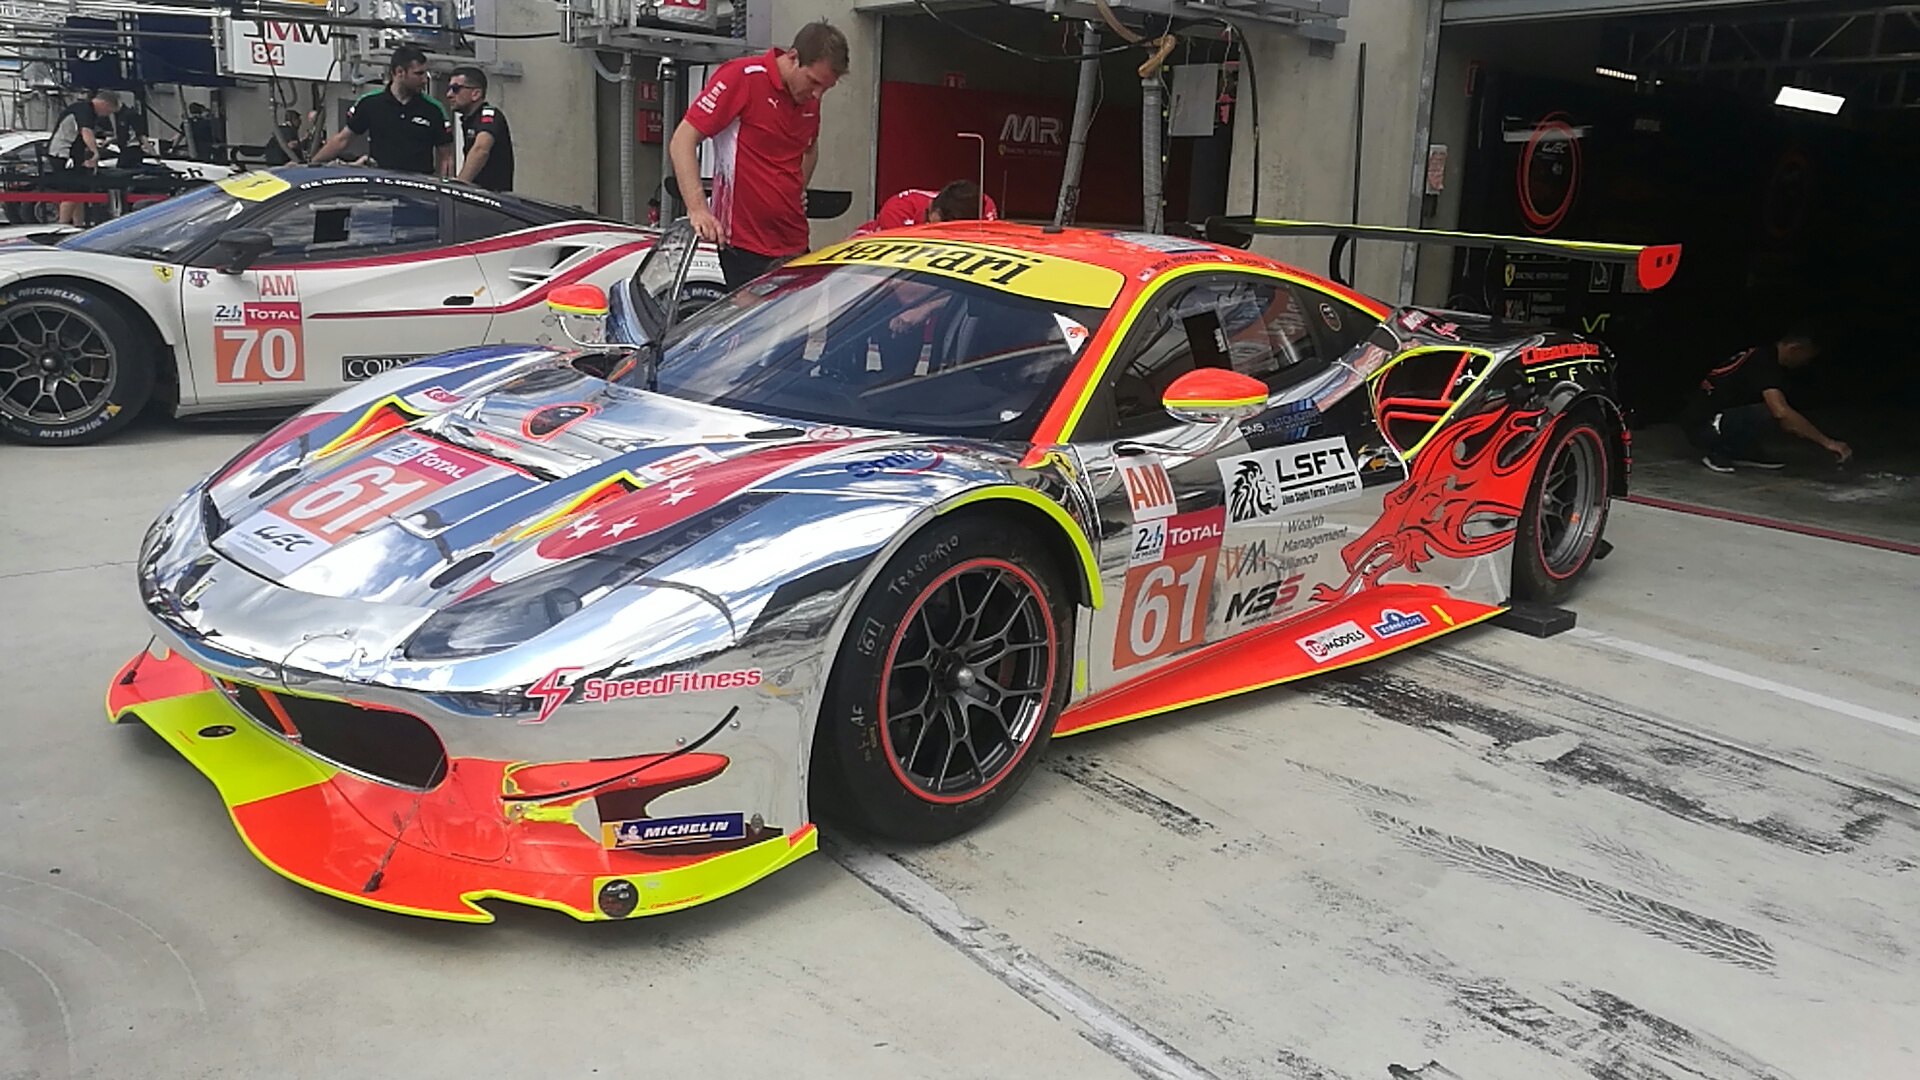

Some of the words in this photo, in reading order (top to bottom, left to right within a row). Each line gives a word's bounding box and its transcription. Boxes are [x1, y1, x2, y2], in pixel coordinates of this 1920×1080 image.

[411, 6, 438, 24] 31
[253, 43, 283, 64] 84
[1000, 113, 1063, 145] MR
[818, 239, 1043, 286] Ferrari
[18, 287, 85, 304] MICHELIN
[261, 275, 295, 296] AM
[246, 308, 300, 320] TOTAL
[223, 328, 297, 379] 70
[416, 452, 466, 478] TOTAL
[1275, 447, 1345, 483] LSFT
[288, 466, 429, 534] 61
[1126, 463, 1173, 511] AM
[1169, 523, 1222, 546] TOTAL
[1287, 513, 1325, 534] Wealth
[253, 525, 314, 552] WEC
[1282, 525, 1348, 554] Management
[1130, 555, 1207, 658] 61
[583, 668, 762, 704] SpeedFitness
[644, 821, 729, 839] MICHELIN
